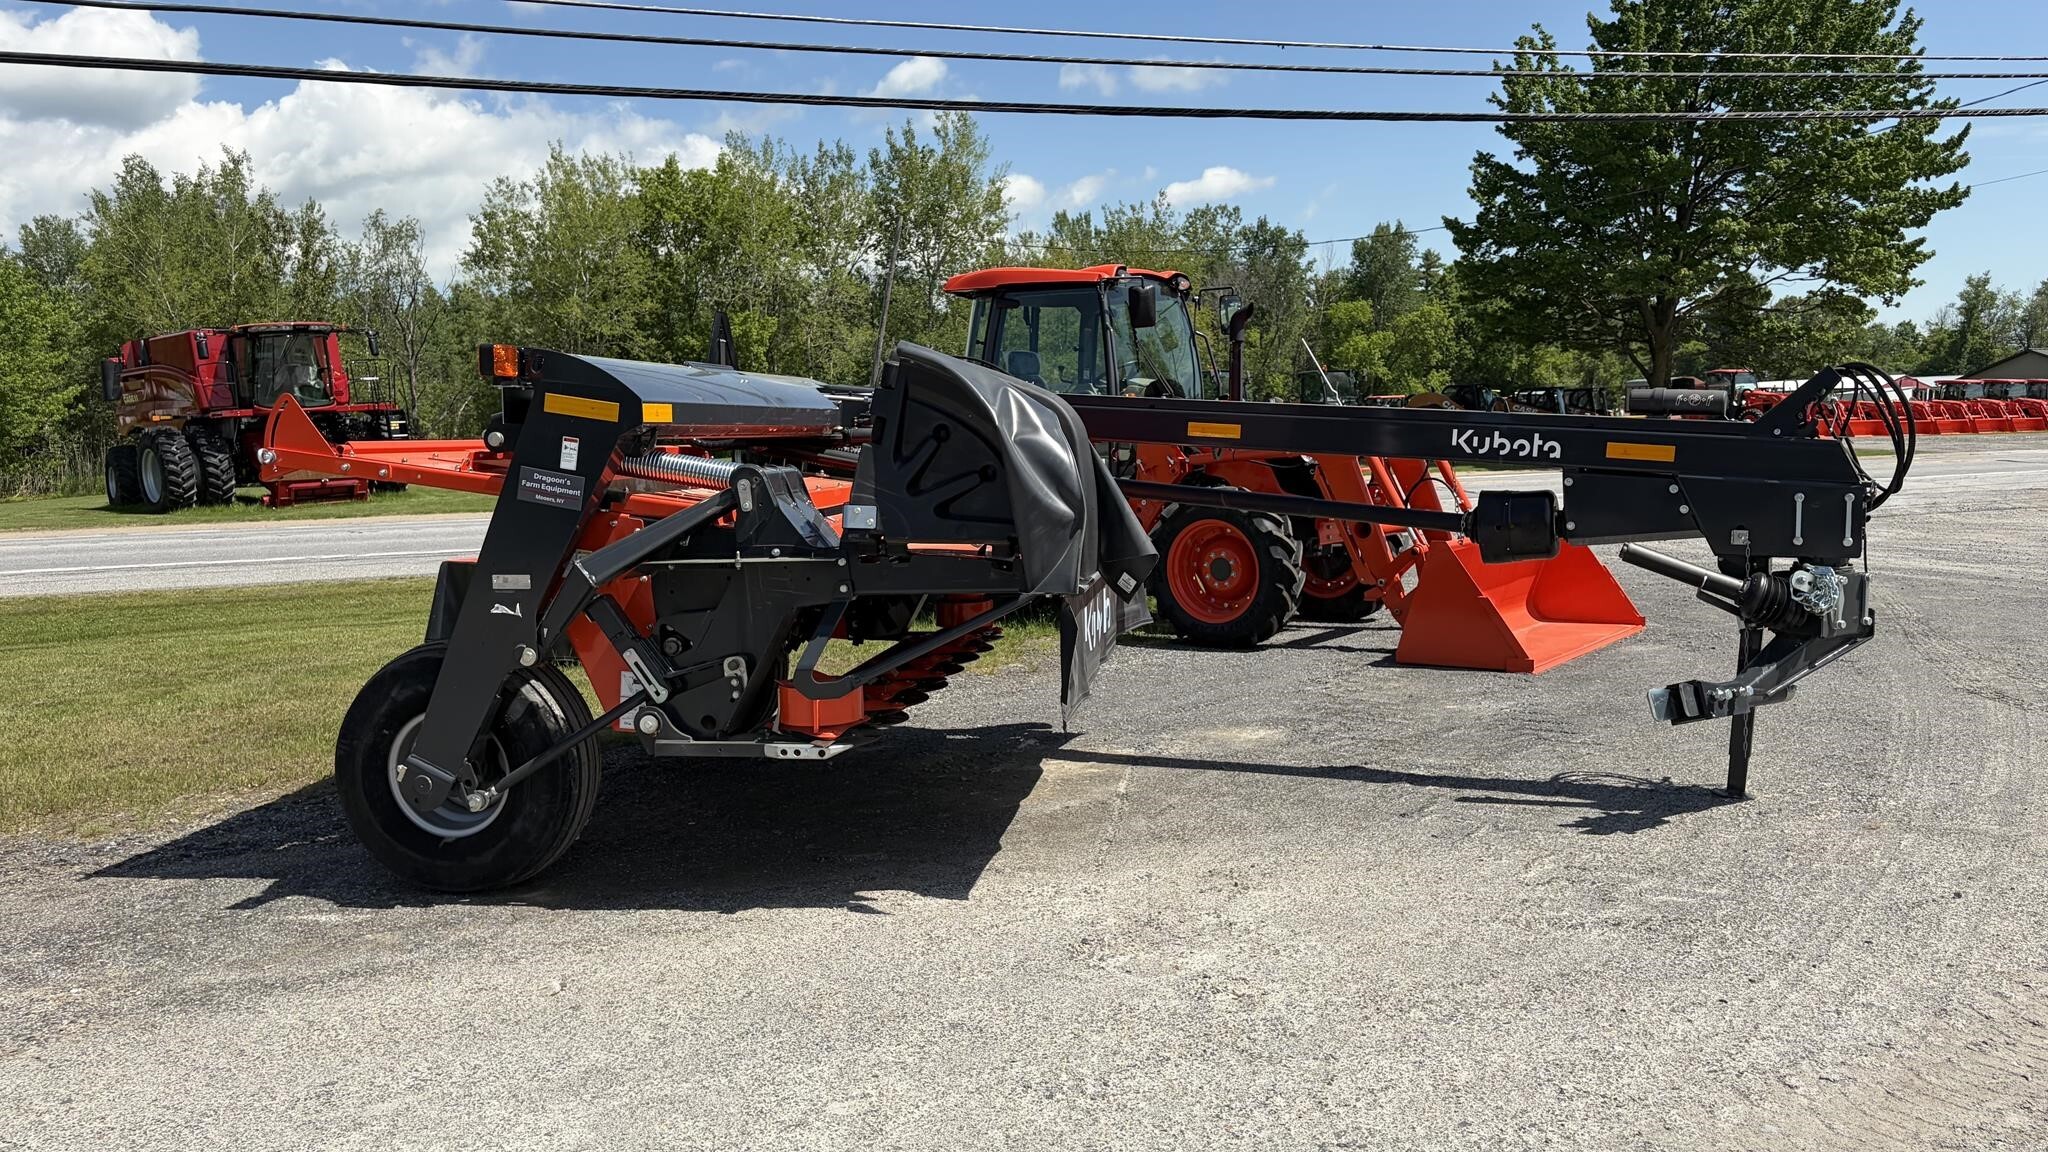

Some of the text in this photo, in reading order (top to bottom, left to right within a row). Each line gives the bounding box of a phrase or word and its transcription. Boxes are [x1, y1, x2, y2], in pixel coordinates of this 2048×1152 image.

[1451, 428, 1562, 459] Kubota
[521, 479, 581, 497] Farm Equipment
[533, 472, 571, 486] Dragoon's
